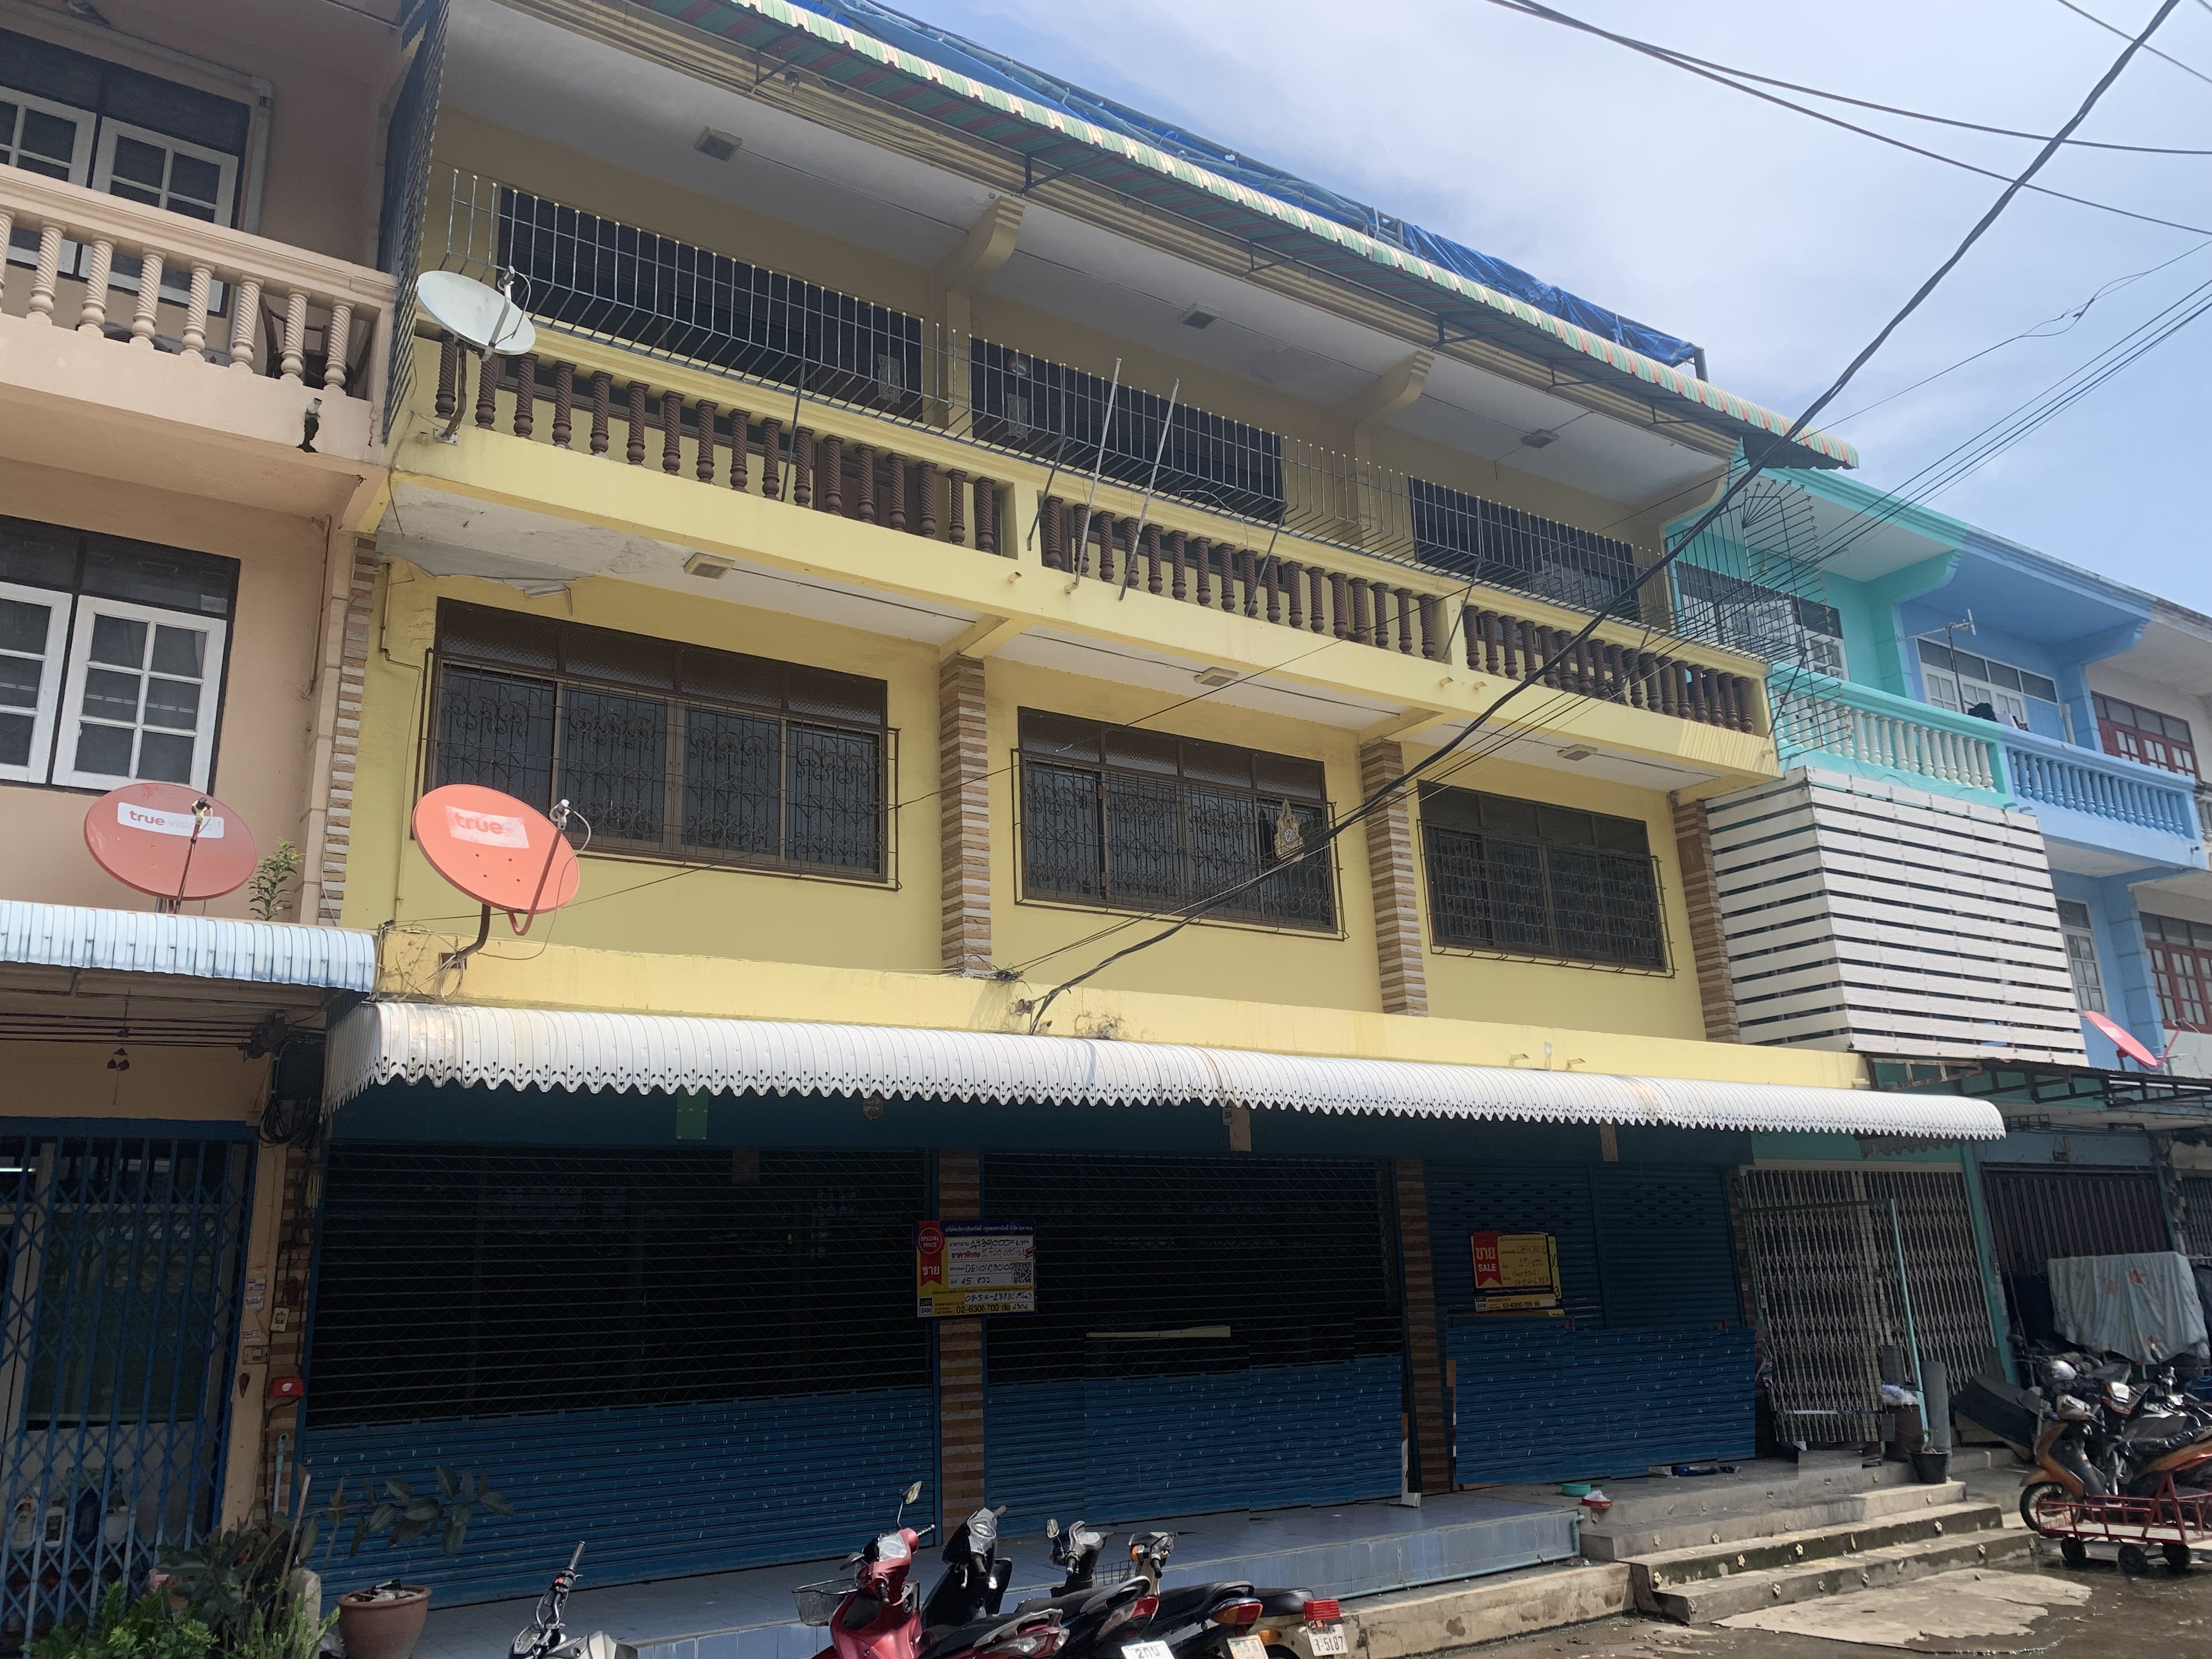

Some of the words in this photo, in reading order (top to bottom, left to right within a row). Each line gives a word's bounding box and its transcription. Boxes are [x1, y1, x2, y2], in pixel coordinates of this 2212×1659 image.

[129, 810, 165, 826] true
[168, 819, 212, 831] visios
[454, 812, 504, 835] true
[1476, 1247, 1496, 1260] ขาย
[922, 1266, 940, 1276] ขาย
[1478, 1263, 1497, 1272] SALE
[1002, 1303, 1011, 1311] ต่อ
